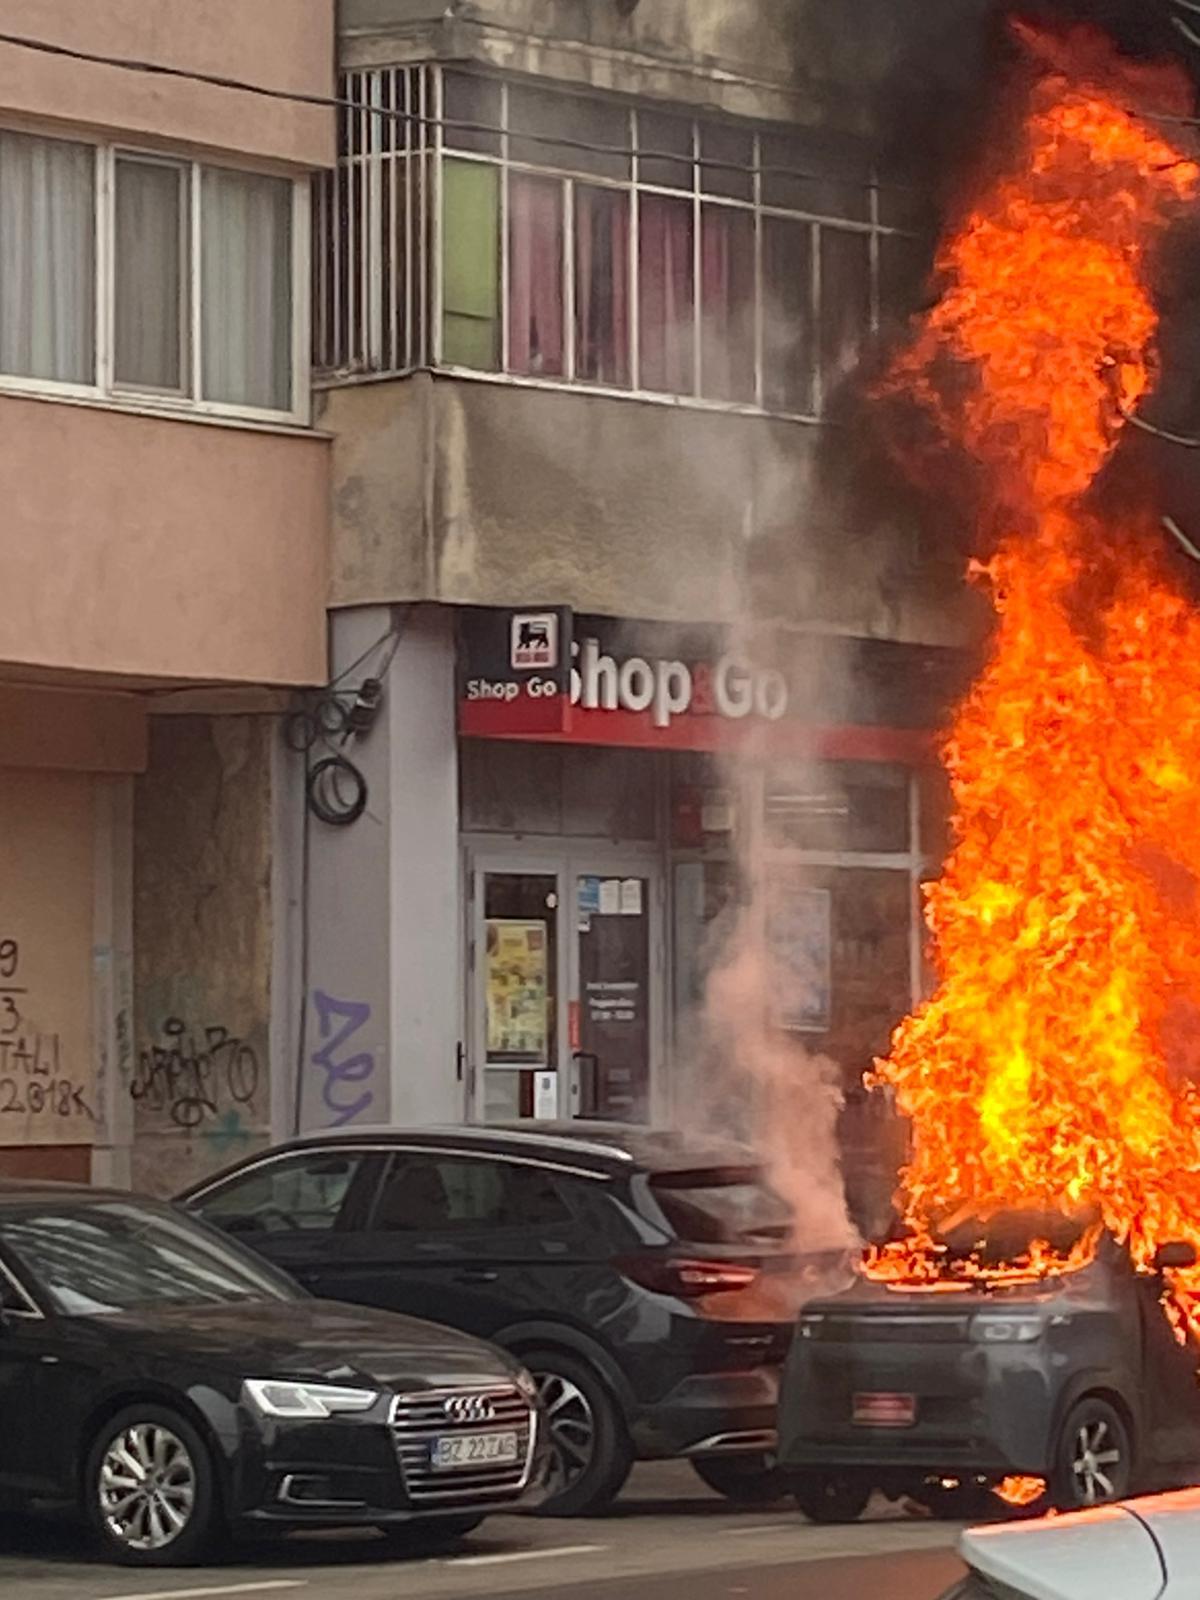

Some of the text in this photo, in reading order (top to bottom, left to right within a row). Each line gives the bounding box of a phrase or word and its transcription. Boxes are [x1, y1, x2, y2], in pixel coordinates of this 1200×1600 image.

[467, 676, 557, 701] Shop Go
[714, 656, 788, 720] Go
